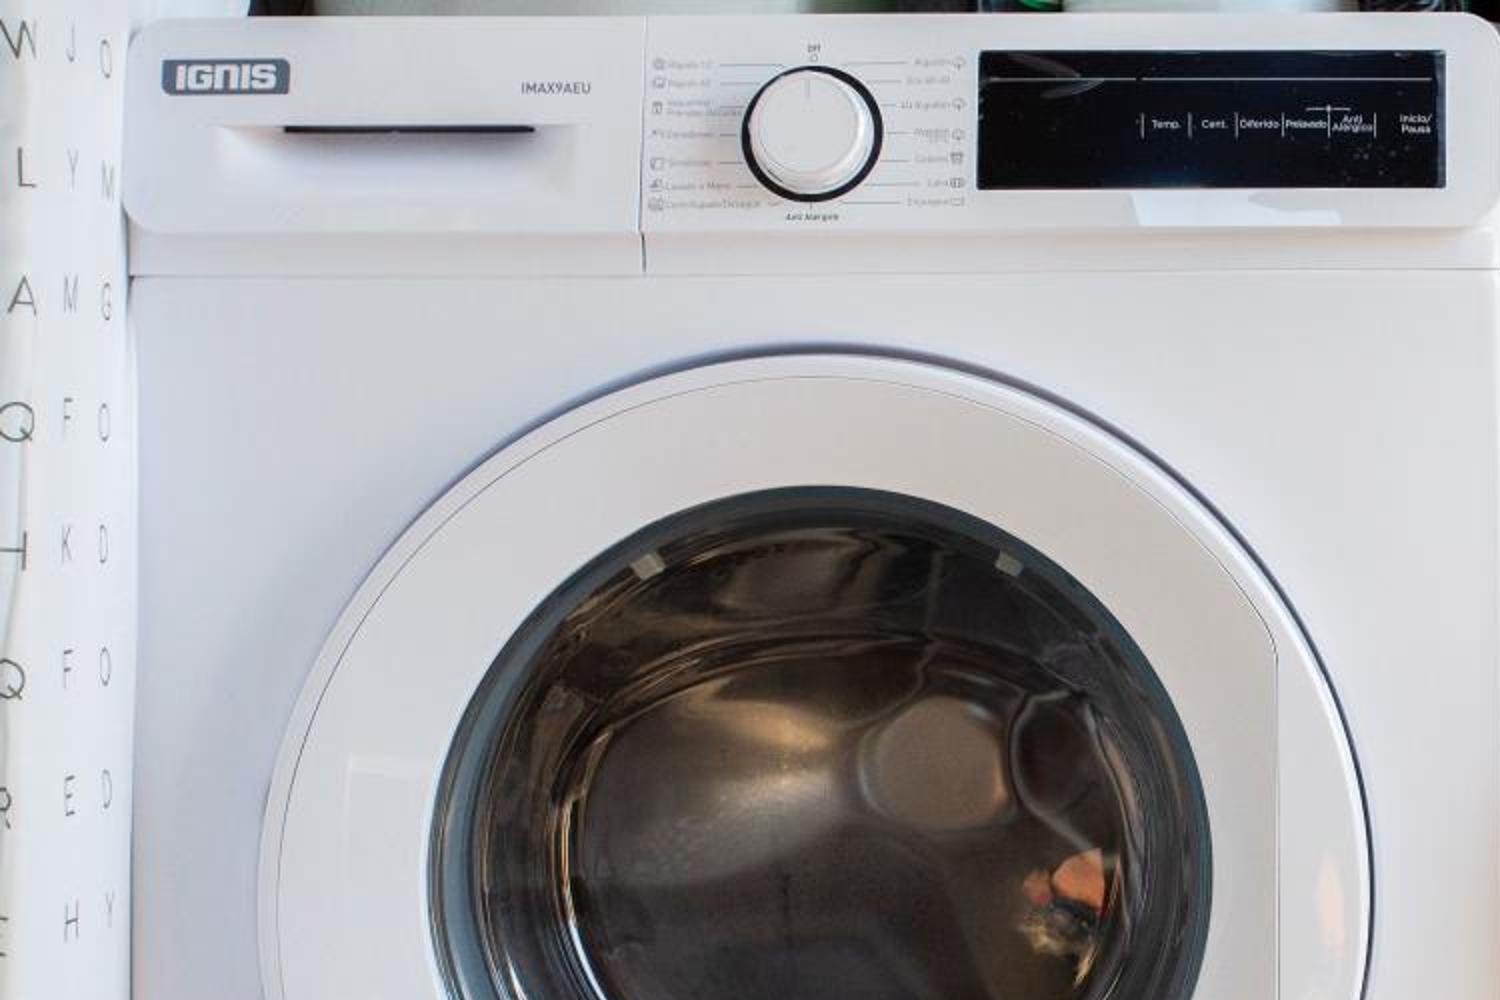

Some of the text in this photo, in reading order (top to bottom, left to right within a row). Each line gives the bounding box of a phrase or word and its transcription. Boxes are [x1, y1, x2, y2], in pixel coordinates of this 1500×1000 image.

[175, 63, 278, 91] IGNIS
[1151, 119, 1182, 130] Temp.
[1240, 118, 1280, 129] Diferido
[1401, 123, 1431, 134] Pausa
[17, 147, 37, 187] L
[8, 275, 37, 316] A
